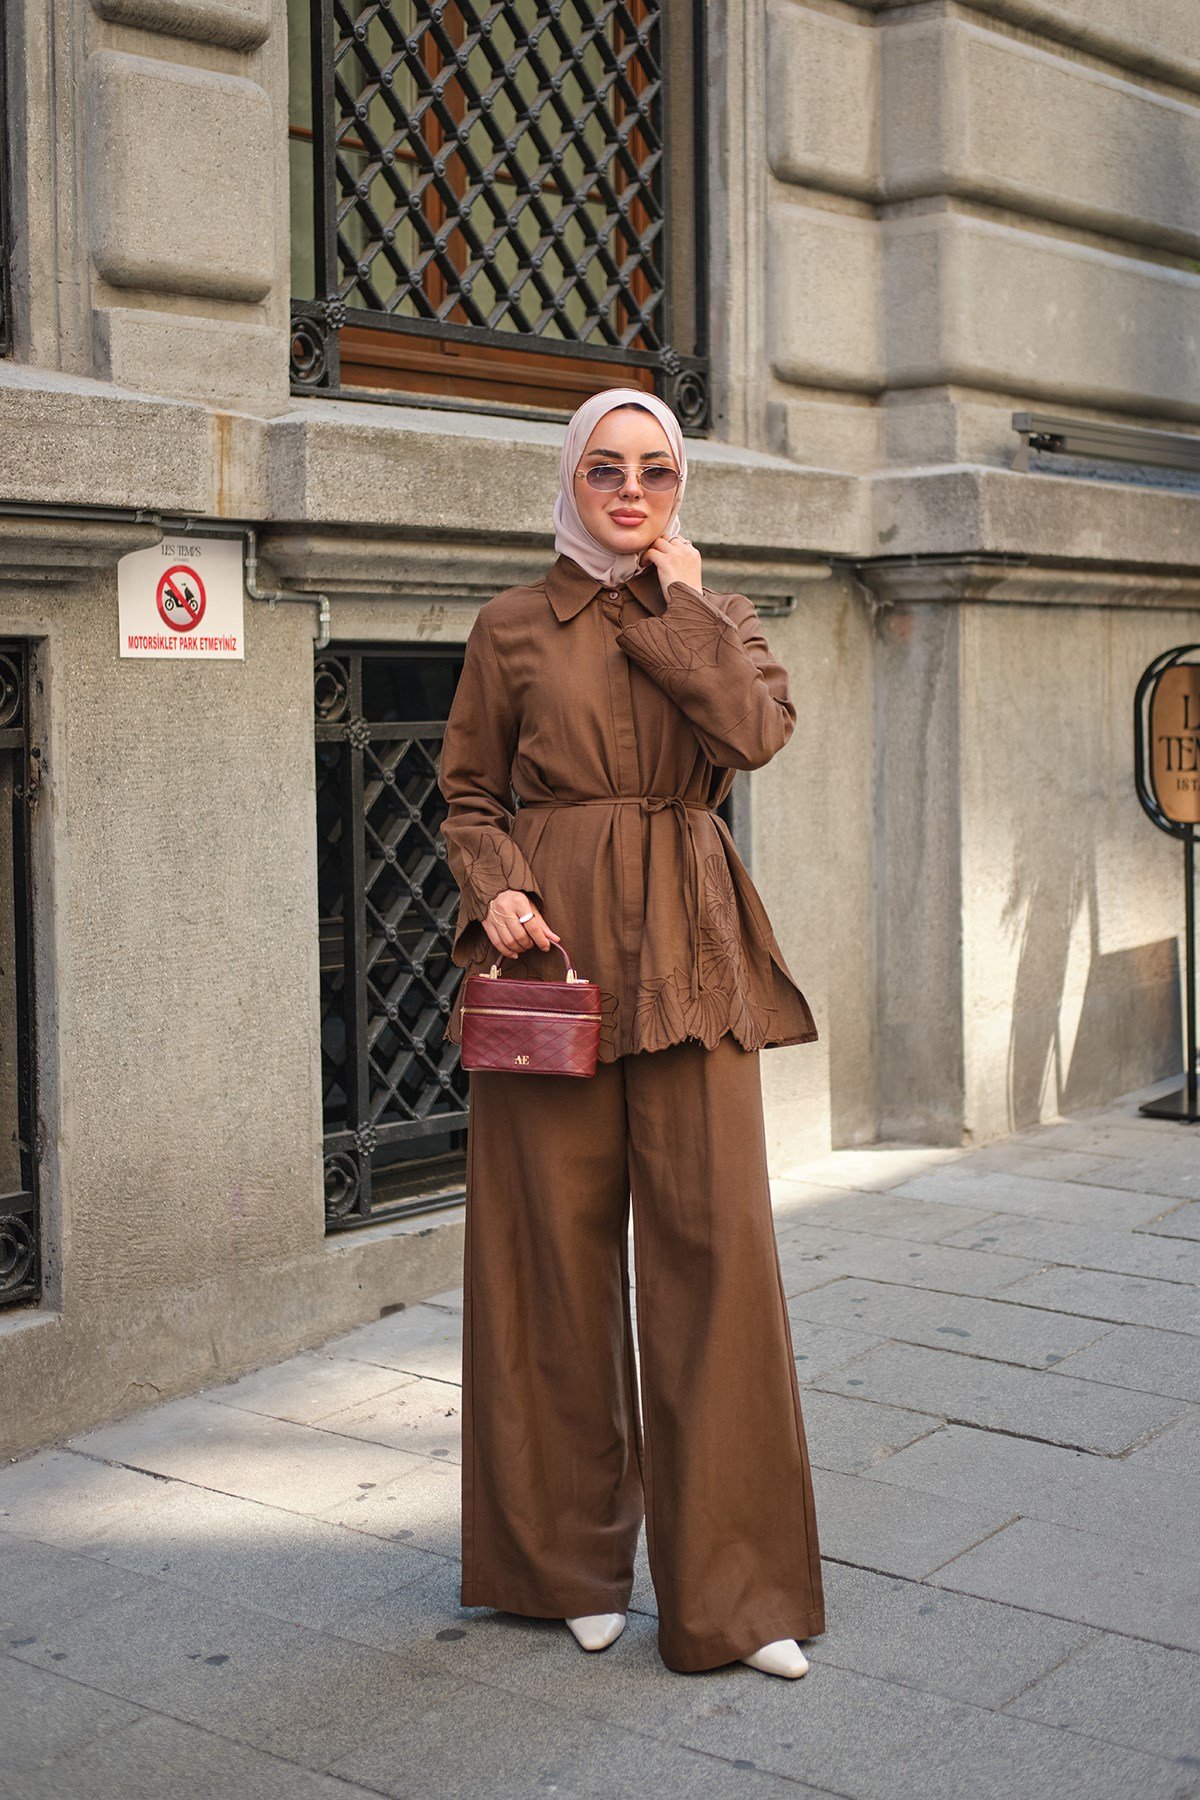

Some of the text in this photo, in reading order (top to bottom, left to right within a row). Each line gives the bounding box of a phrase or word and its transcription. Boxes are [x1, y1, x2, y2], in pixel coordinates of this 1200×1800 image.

[161, 545, 201, 558] LES TEMPS
[128, 634, 237, 651] MOTORSİKLET PARK ETMEYİNİZ
[1183, 694, 1200, 730] L
[1176, 778, 1200, 791] IST
[514, 1054, 530, 1065] AE
